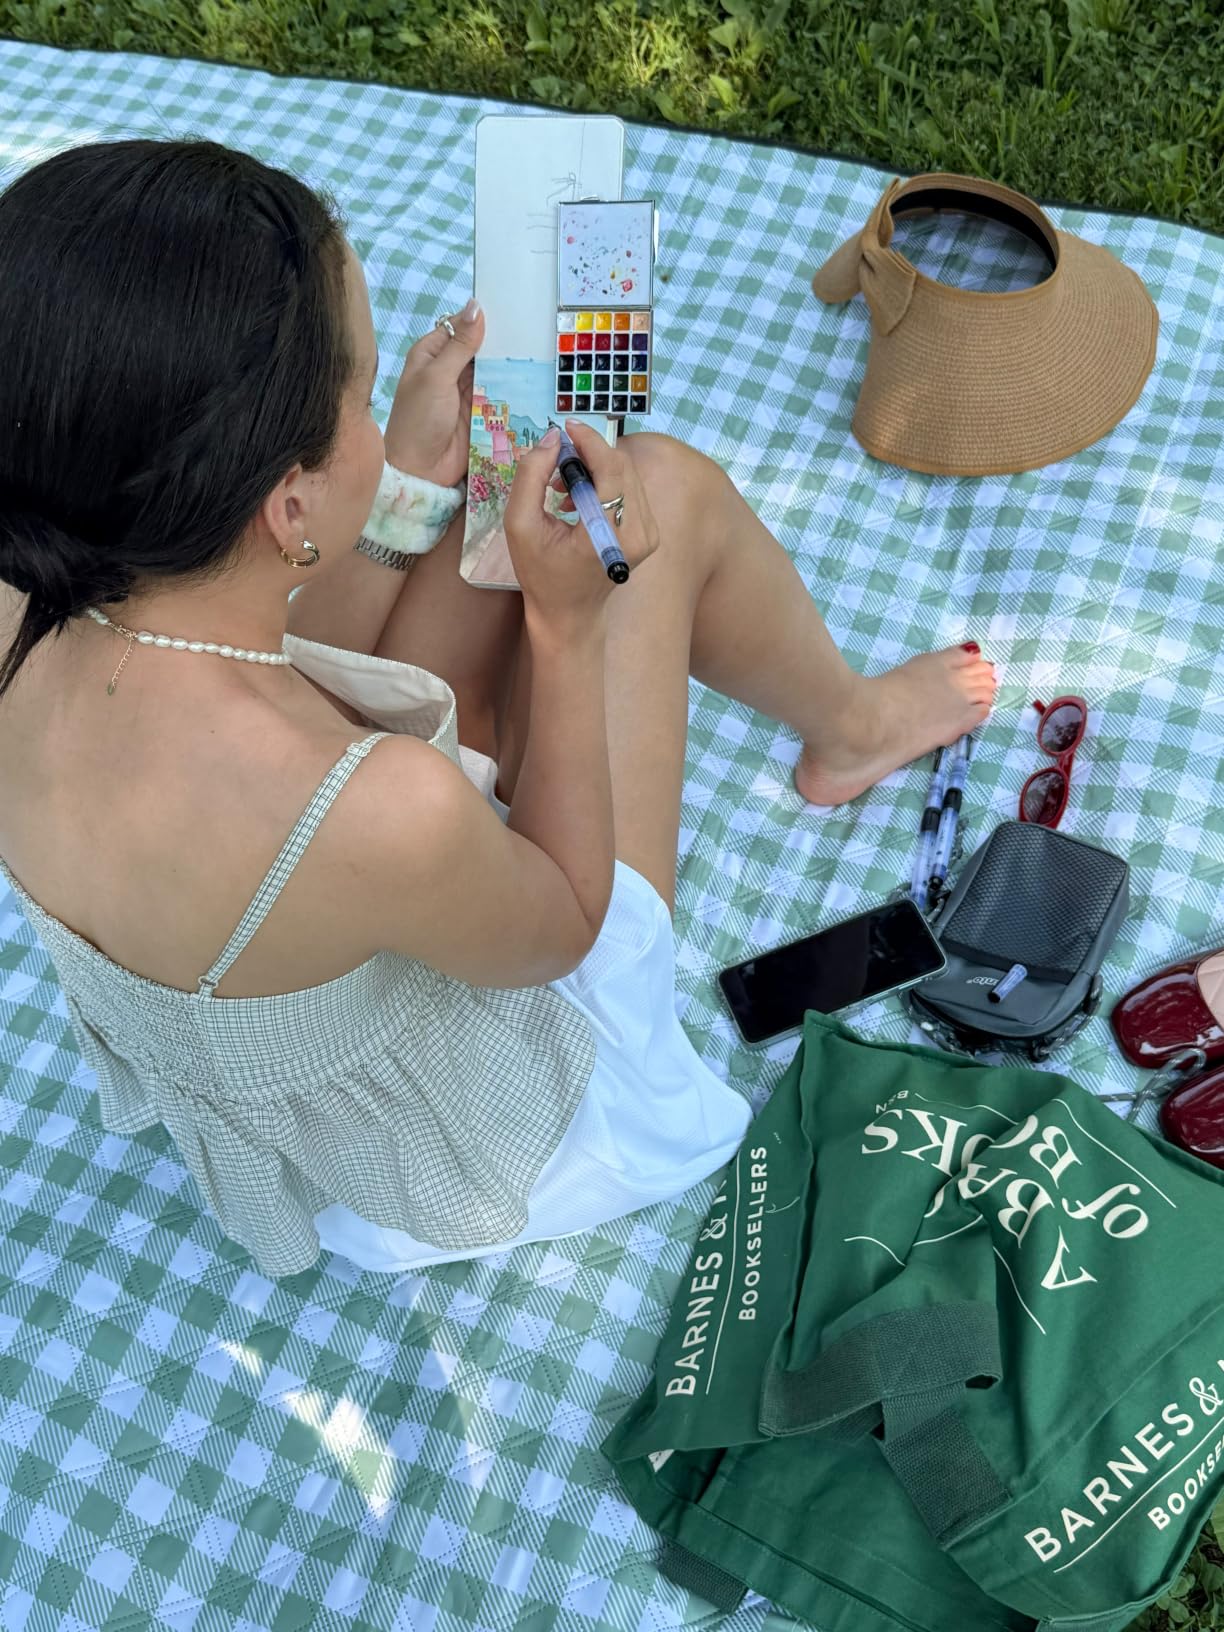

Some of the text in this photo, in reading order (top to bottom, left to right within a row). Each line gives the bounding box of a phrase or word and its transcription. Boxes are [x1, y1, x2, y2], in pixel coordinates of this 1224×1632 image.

[738, 1146, 768, 1321] BOOKSELLERS
[923, 1162, 1098, 1290] A BA
[1061, 1183, 1149, 1239] of
[665, 1213, 728, 1397] BARNES &
[1024, 1376, 1224, 1563] BARNES &
[1147, 1434, 1224, 1531] BOOKSE
